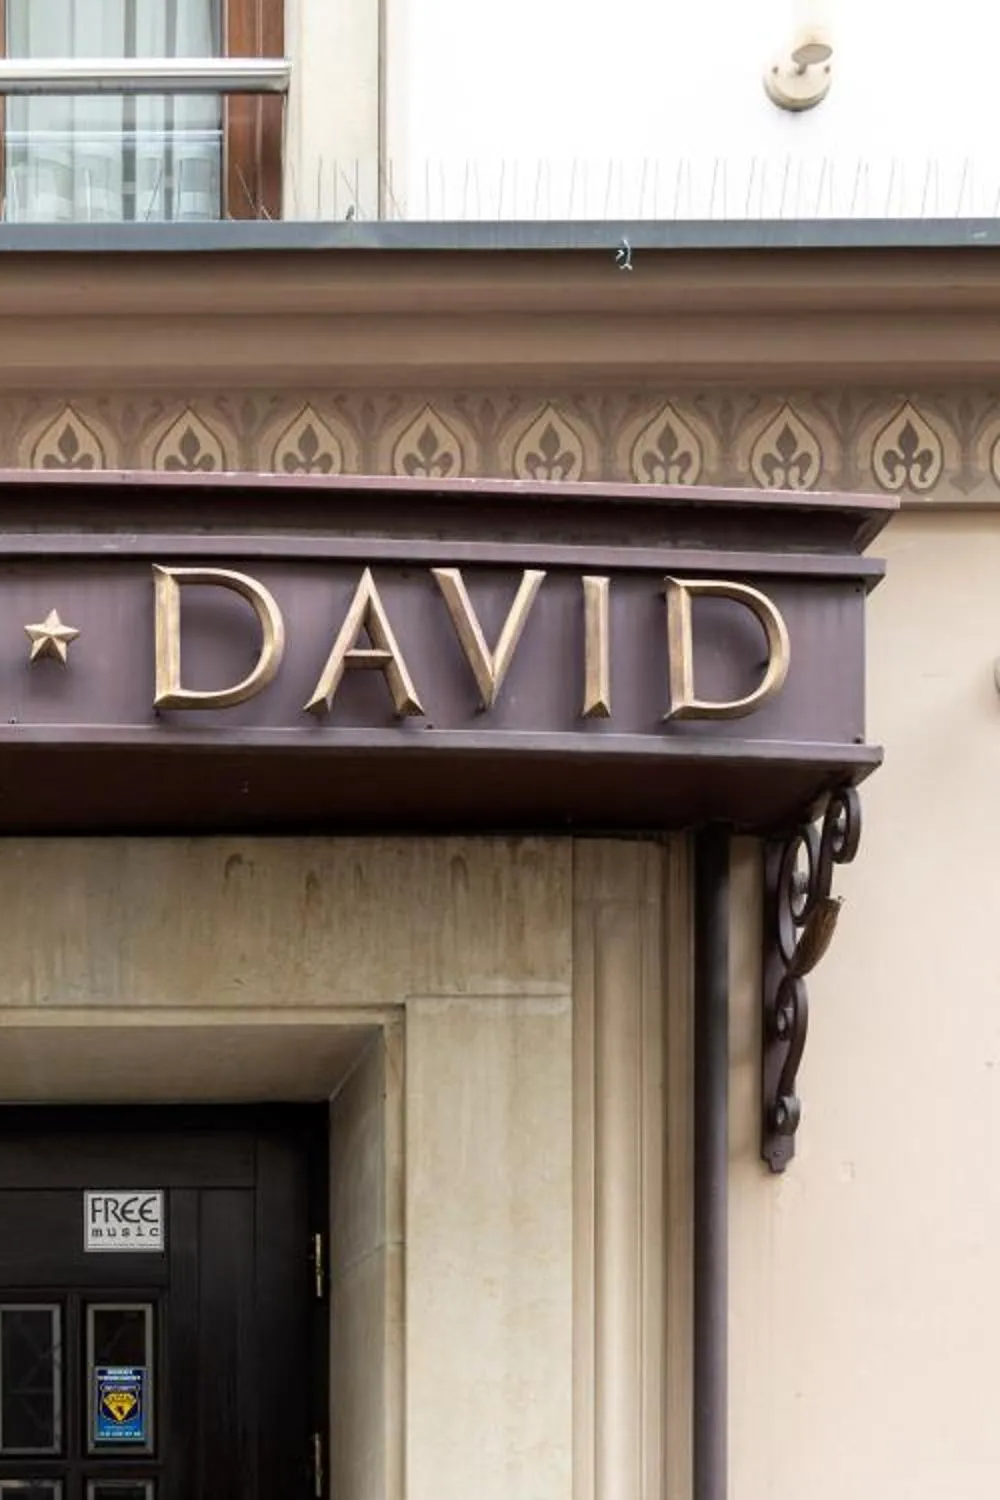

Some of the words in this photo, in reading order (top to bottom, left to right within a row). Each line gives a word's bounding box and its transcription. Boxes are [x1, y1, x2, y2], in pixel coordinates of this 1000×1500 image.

[151, 563, 791, 723] DAVID
[91, 1196, 159, 1223] FREE
[91, 1226, 161, 1237] music
